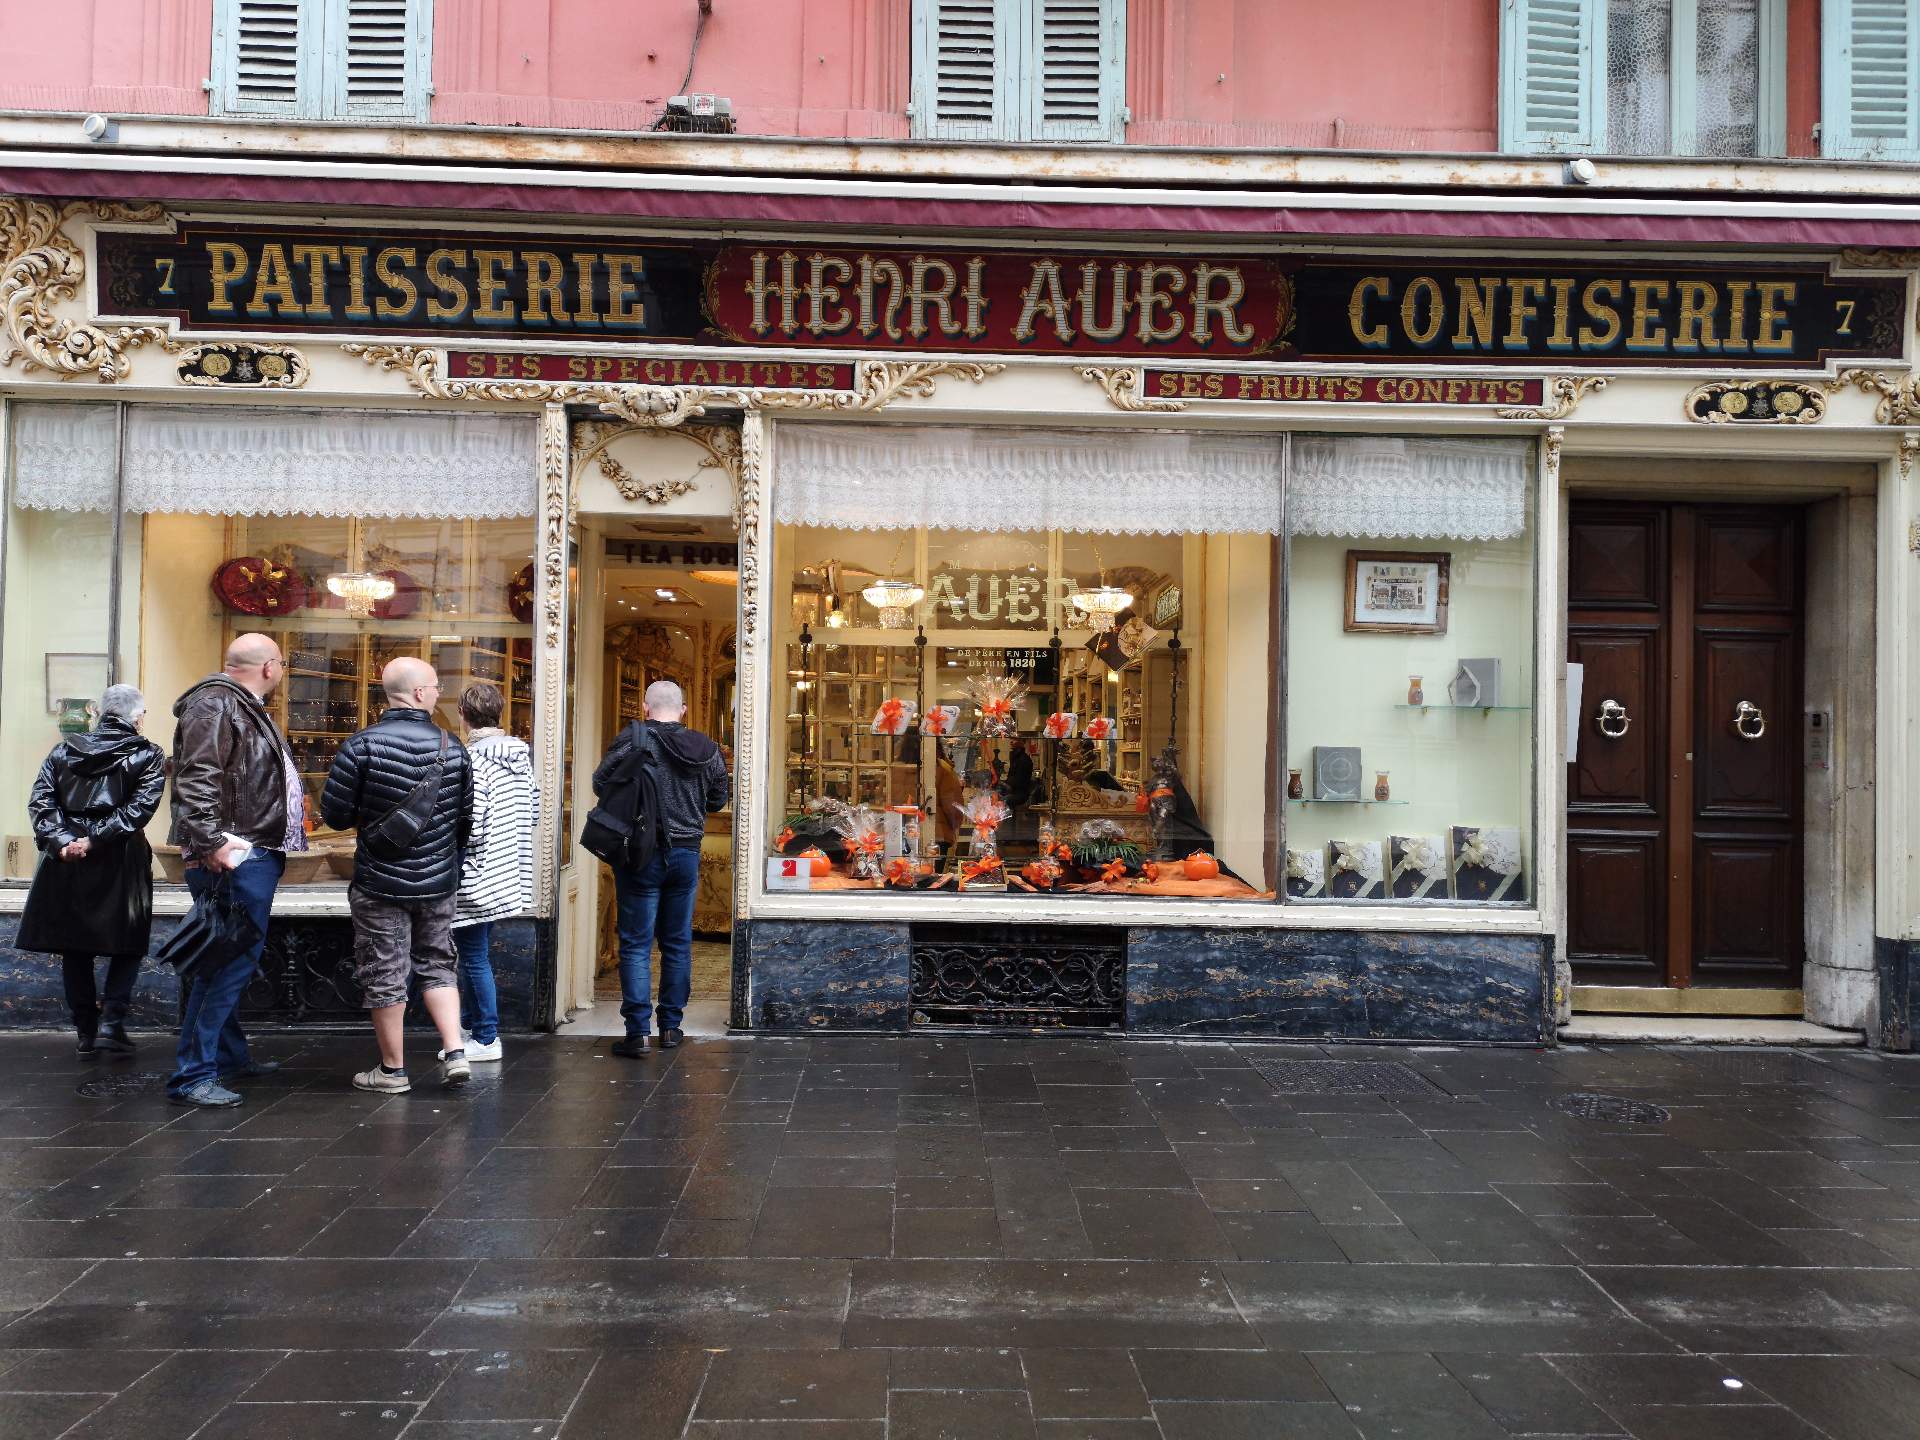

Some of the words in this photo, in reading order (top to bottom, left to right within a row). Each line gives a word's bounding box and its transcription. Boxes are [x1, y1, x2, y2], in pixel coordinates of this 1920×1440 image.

[155, 258, 176, 294] 7
[205, 241, 647, 327] PATISSERIE
[744, 249, 991, 341] HENRI
[1011, 258, 1256, 346] AUER
[1347, 276, 1798, 353] CONFISERIE
[1834, 300, 1855, 335] 7
[465, 354, 541, 378] SES
[568, 357, 837, 387] SPECIALITES
[1159, 373, 1224, 398] SES
[1238, 375, 1365, 400] FRUITS
[1376, 378, 1526, 404] CONFITS
[624, 543, 672, 564] TEA
[919, 572, 1088, 624] AUER
[957, 649, 971, 657] DE
[1006, 649, 1020, 658] EN
[1024, 649, 1048, 659] FILS
[1009, 658, 1036, 668] 1820
